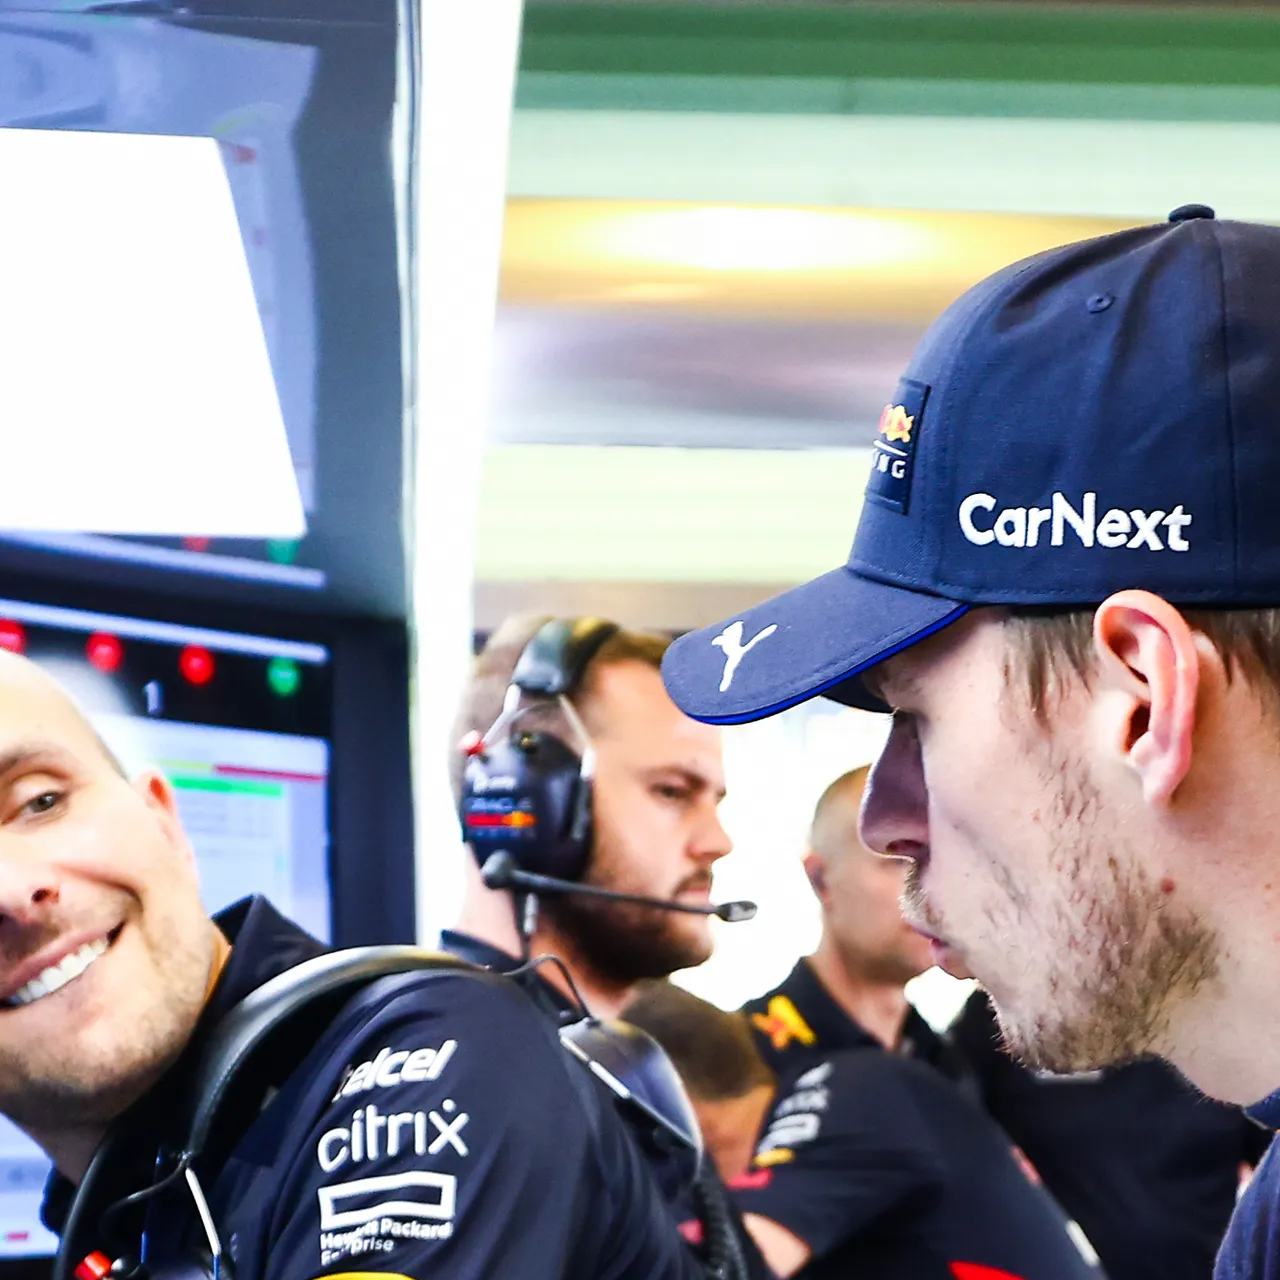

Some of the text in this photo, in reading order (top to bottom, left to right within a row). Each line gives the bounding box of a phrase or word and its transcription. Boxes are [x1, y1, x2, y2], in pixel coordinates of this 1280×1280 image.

[958, 491, 1193, 552] CarNext
[318, 1099, 469, 1173] citrix
[381, 1218, 453, 1240] Packard
